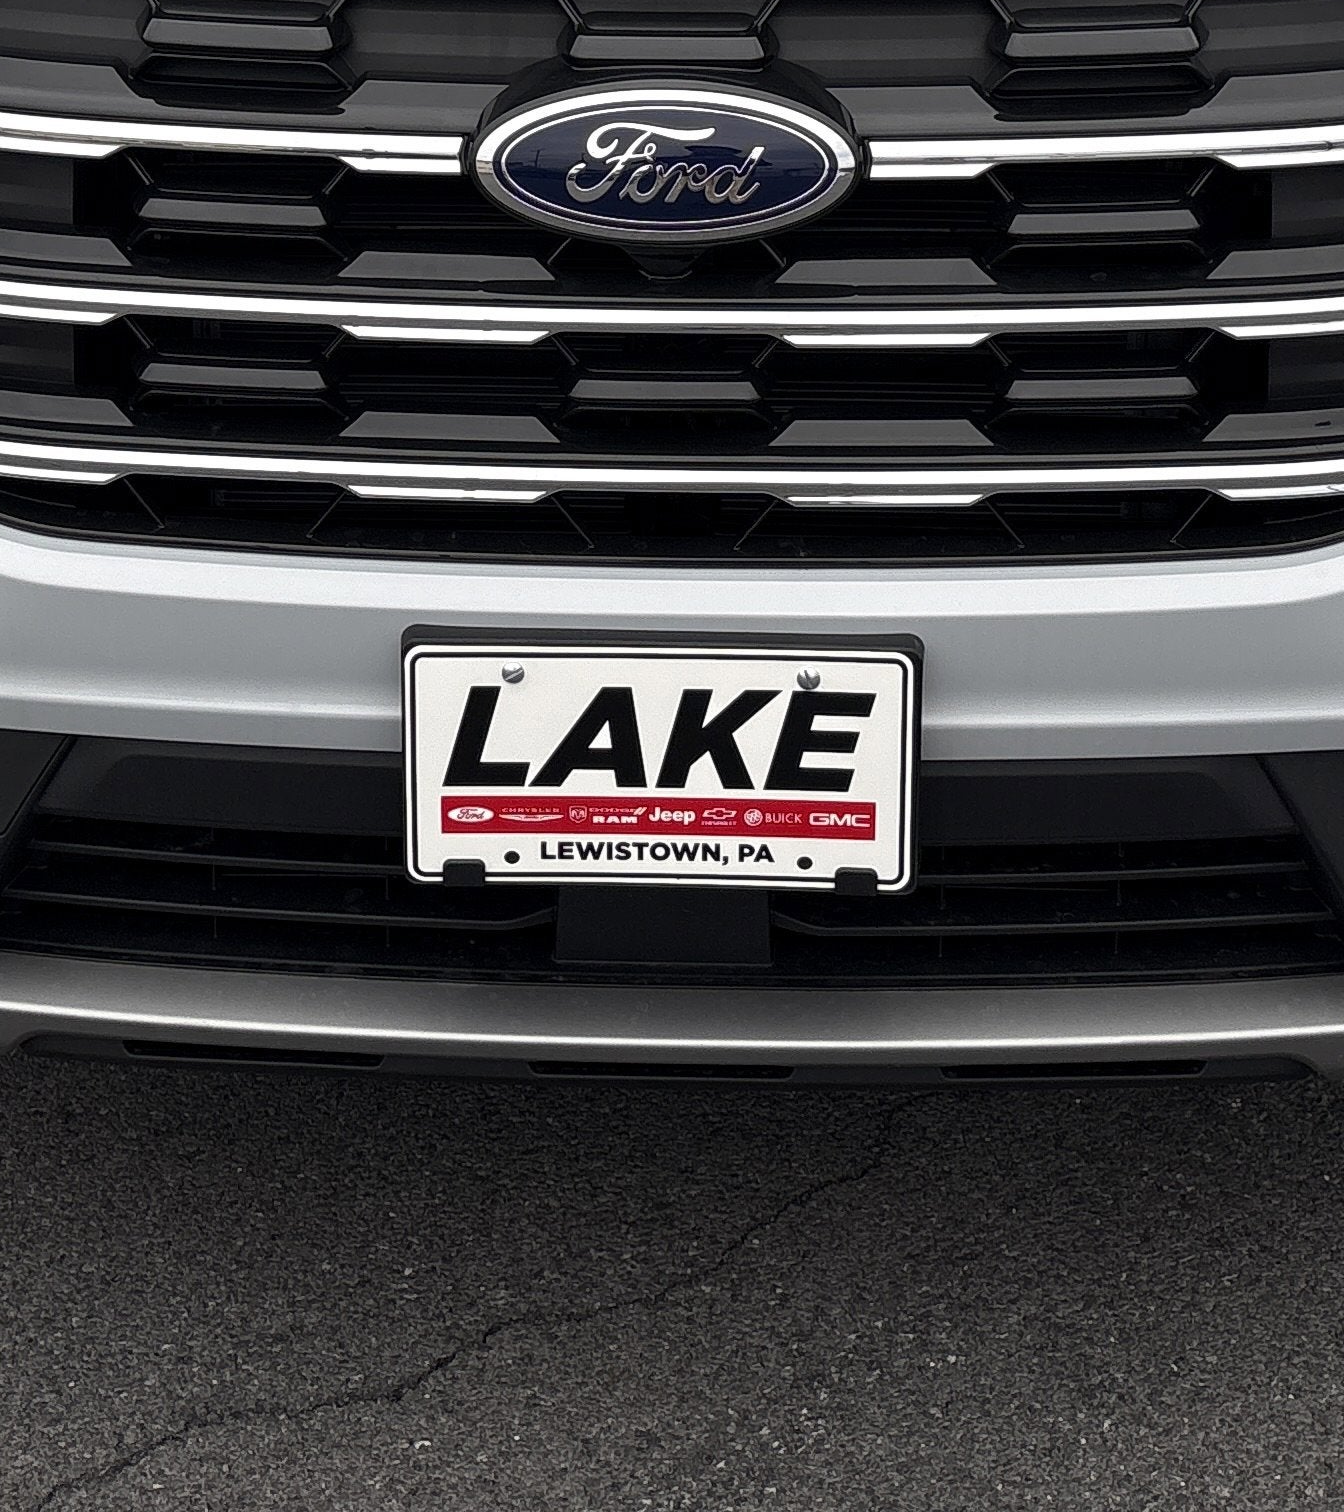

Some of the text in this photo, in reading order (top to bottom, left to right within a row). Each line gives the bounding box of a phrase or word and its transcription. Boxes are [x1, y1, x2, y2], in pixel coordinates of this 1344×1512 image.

[566, 122, 765, 204] Ford
[442, 685, 877, 792] LAKE
[457, 808, 485, 820] Ford
[592, 815, 638, 824] RAM
[648, 806, 696, 826] Jeep
[765, 812, 803, 824] BUICK
[809, 812, 871, 828] GMC
[540, 840, 775, 866] LEWISTOWN, PA
